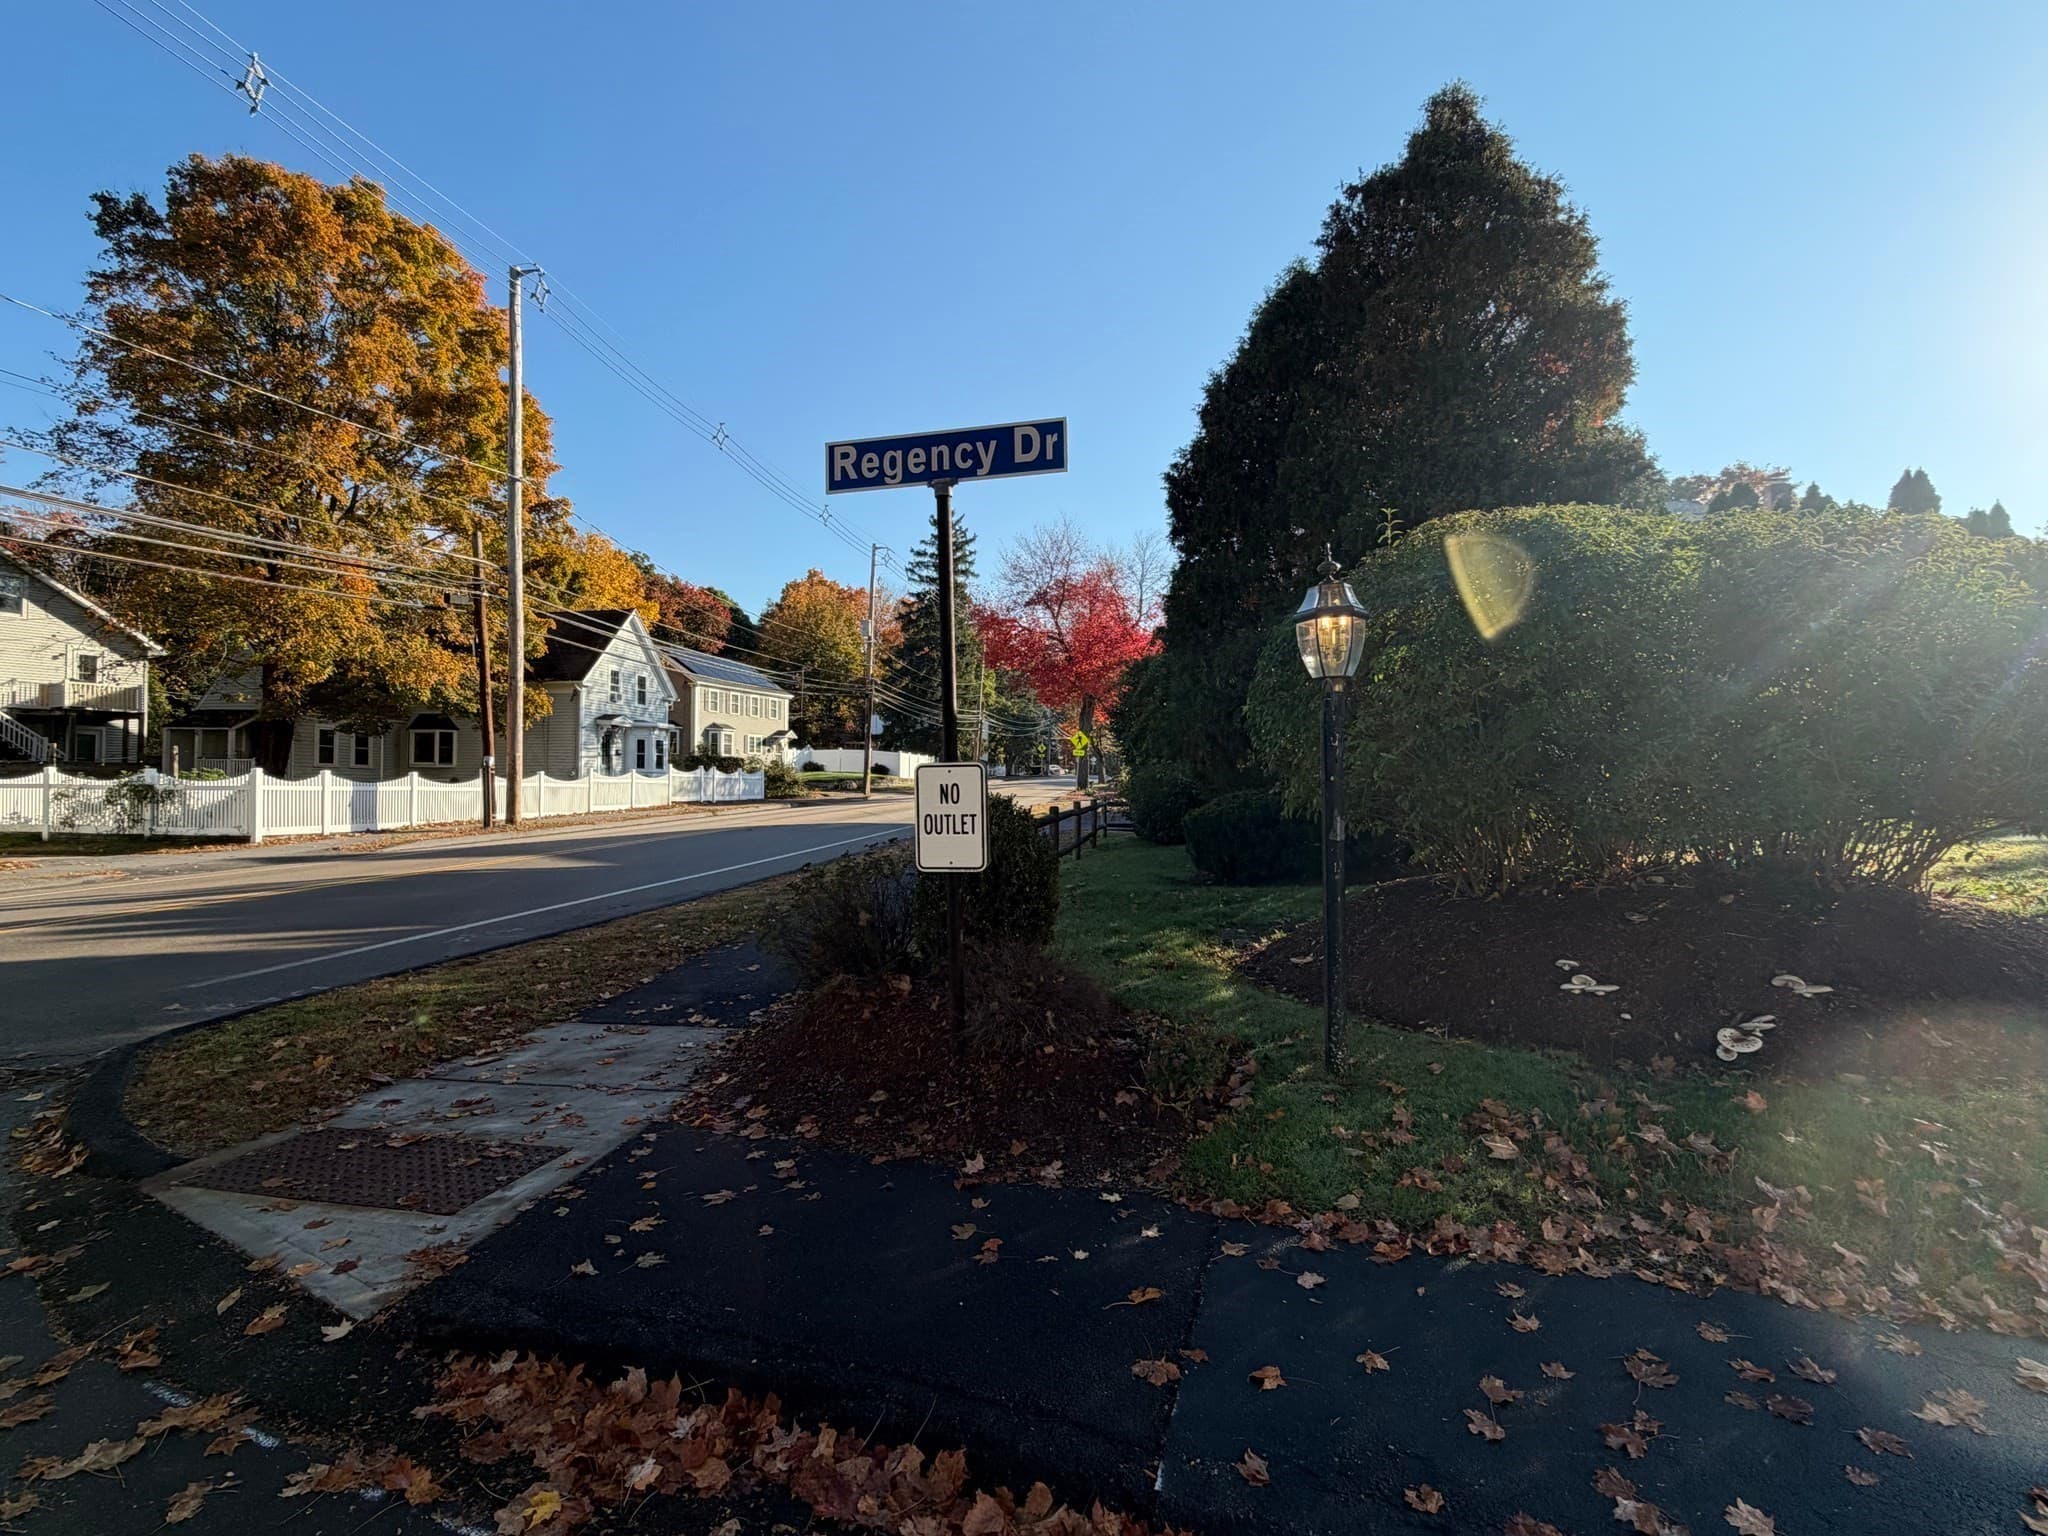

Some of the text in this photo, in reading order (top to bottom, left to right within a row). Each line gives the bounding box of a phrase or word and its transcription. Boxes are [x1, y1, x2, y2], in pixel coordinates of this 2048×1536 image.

[833, 426, 1058, 484] Regency Dr
[939, 783, 960, 805] NO
[924, 813, 977, 835] OUTLET
